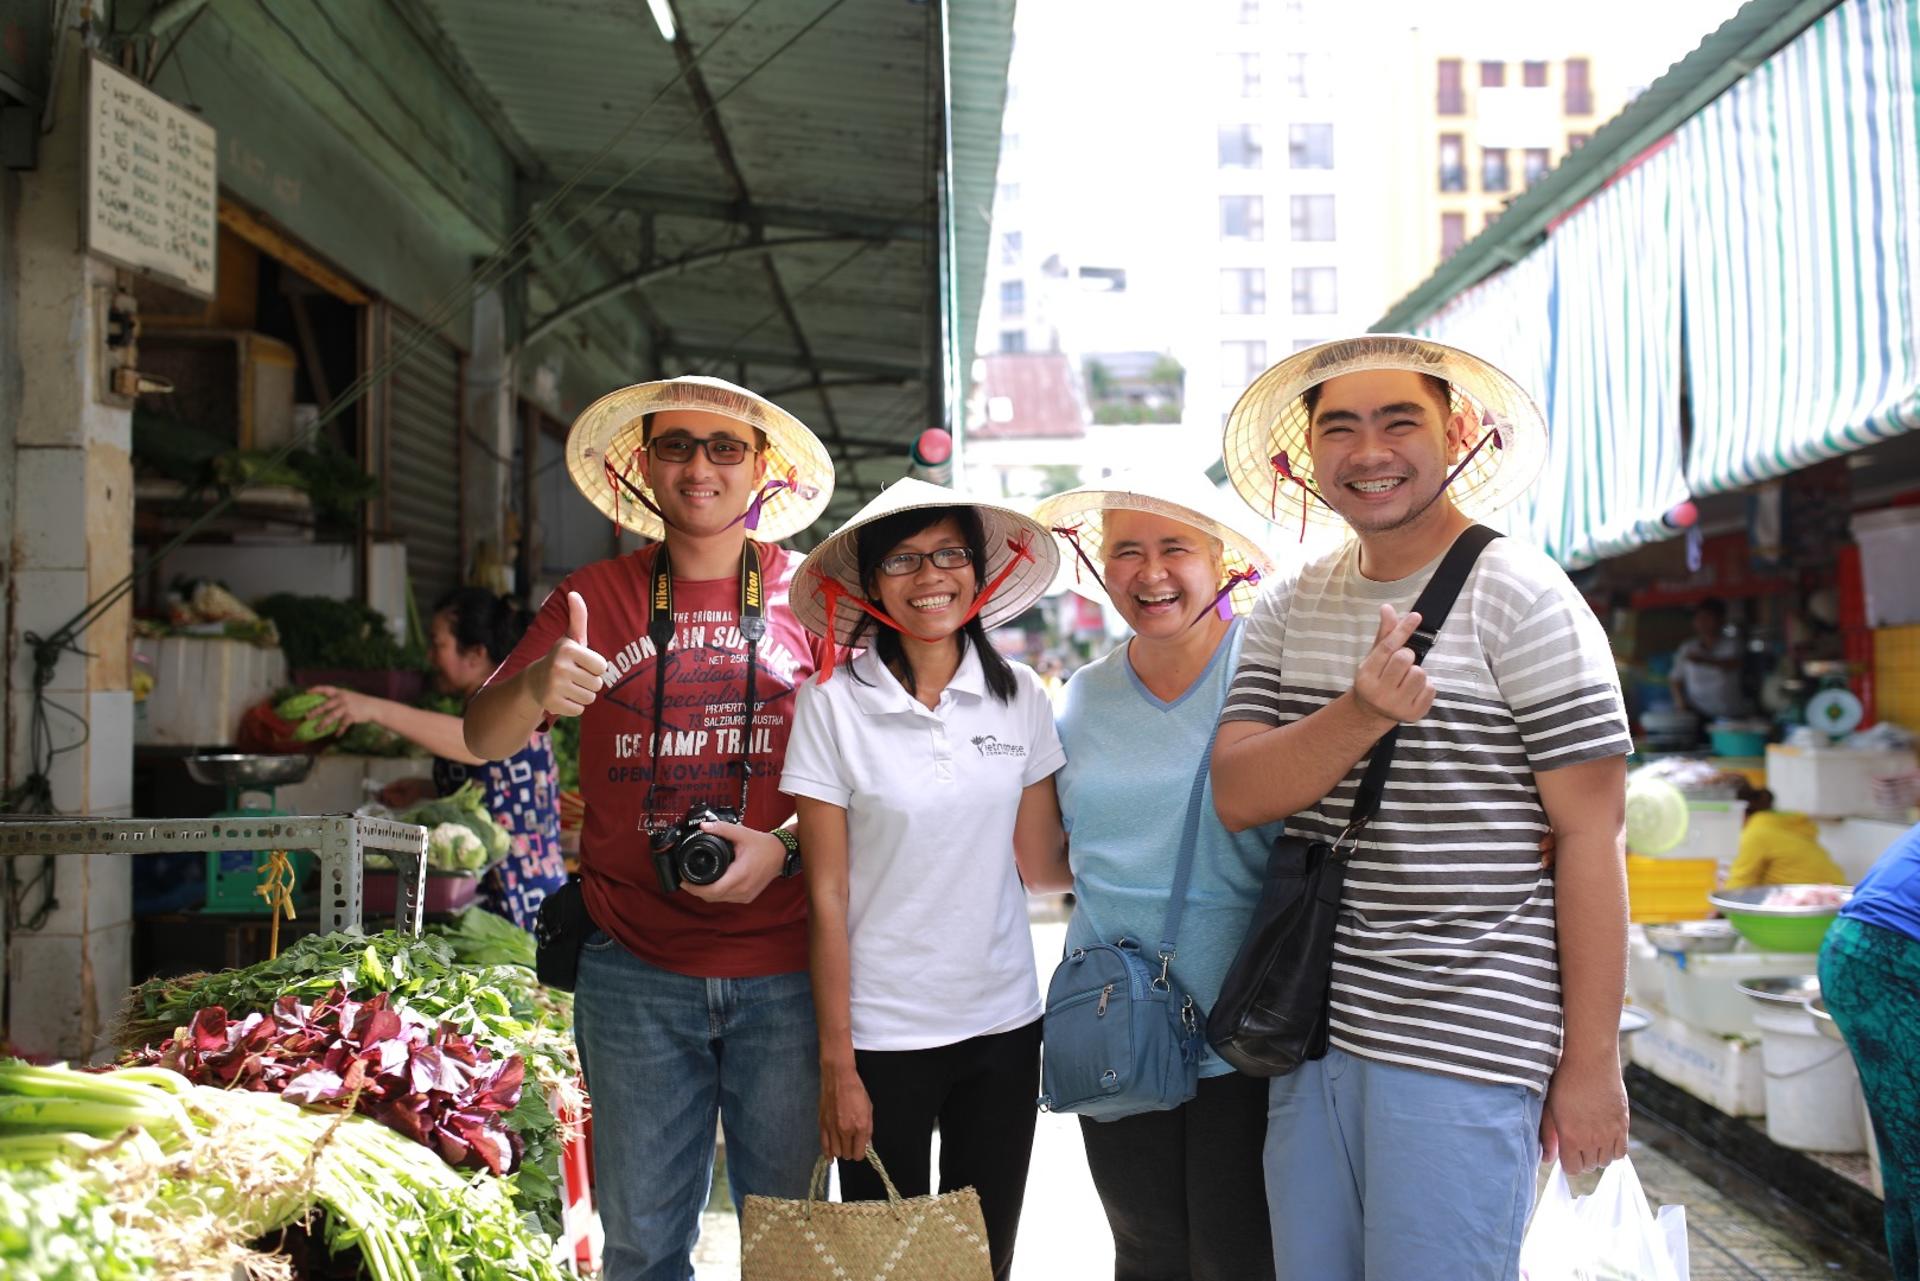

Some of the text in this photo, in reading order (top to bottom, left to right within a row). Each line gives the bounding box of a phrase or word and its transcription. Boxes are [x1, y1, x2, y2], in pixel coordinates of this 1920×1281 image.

[656, 573, 668, 609] Nikon
[747, 571, 759, 607] Nikon
[673, 610, 732, 624] THE ORIGINAL
[602, 625, 705, 688] MOUNAIN
[708, 656, 726, 665] NET
[754, 702, 766, 711] OF
[704, 715, 784, 727] SALZBURG AUSTRIA
[615, 734, 642, 758] ICE
[608, 765, 651, 782] OPEN
